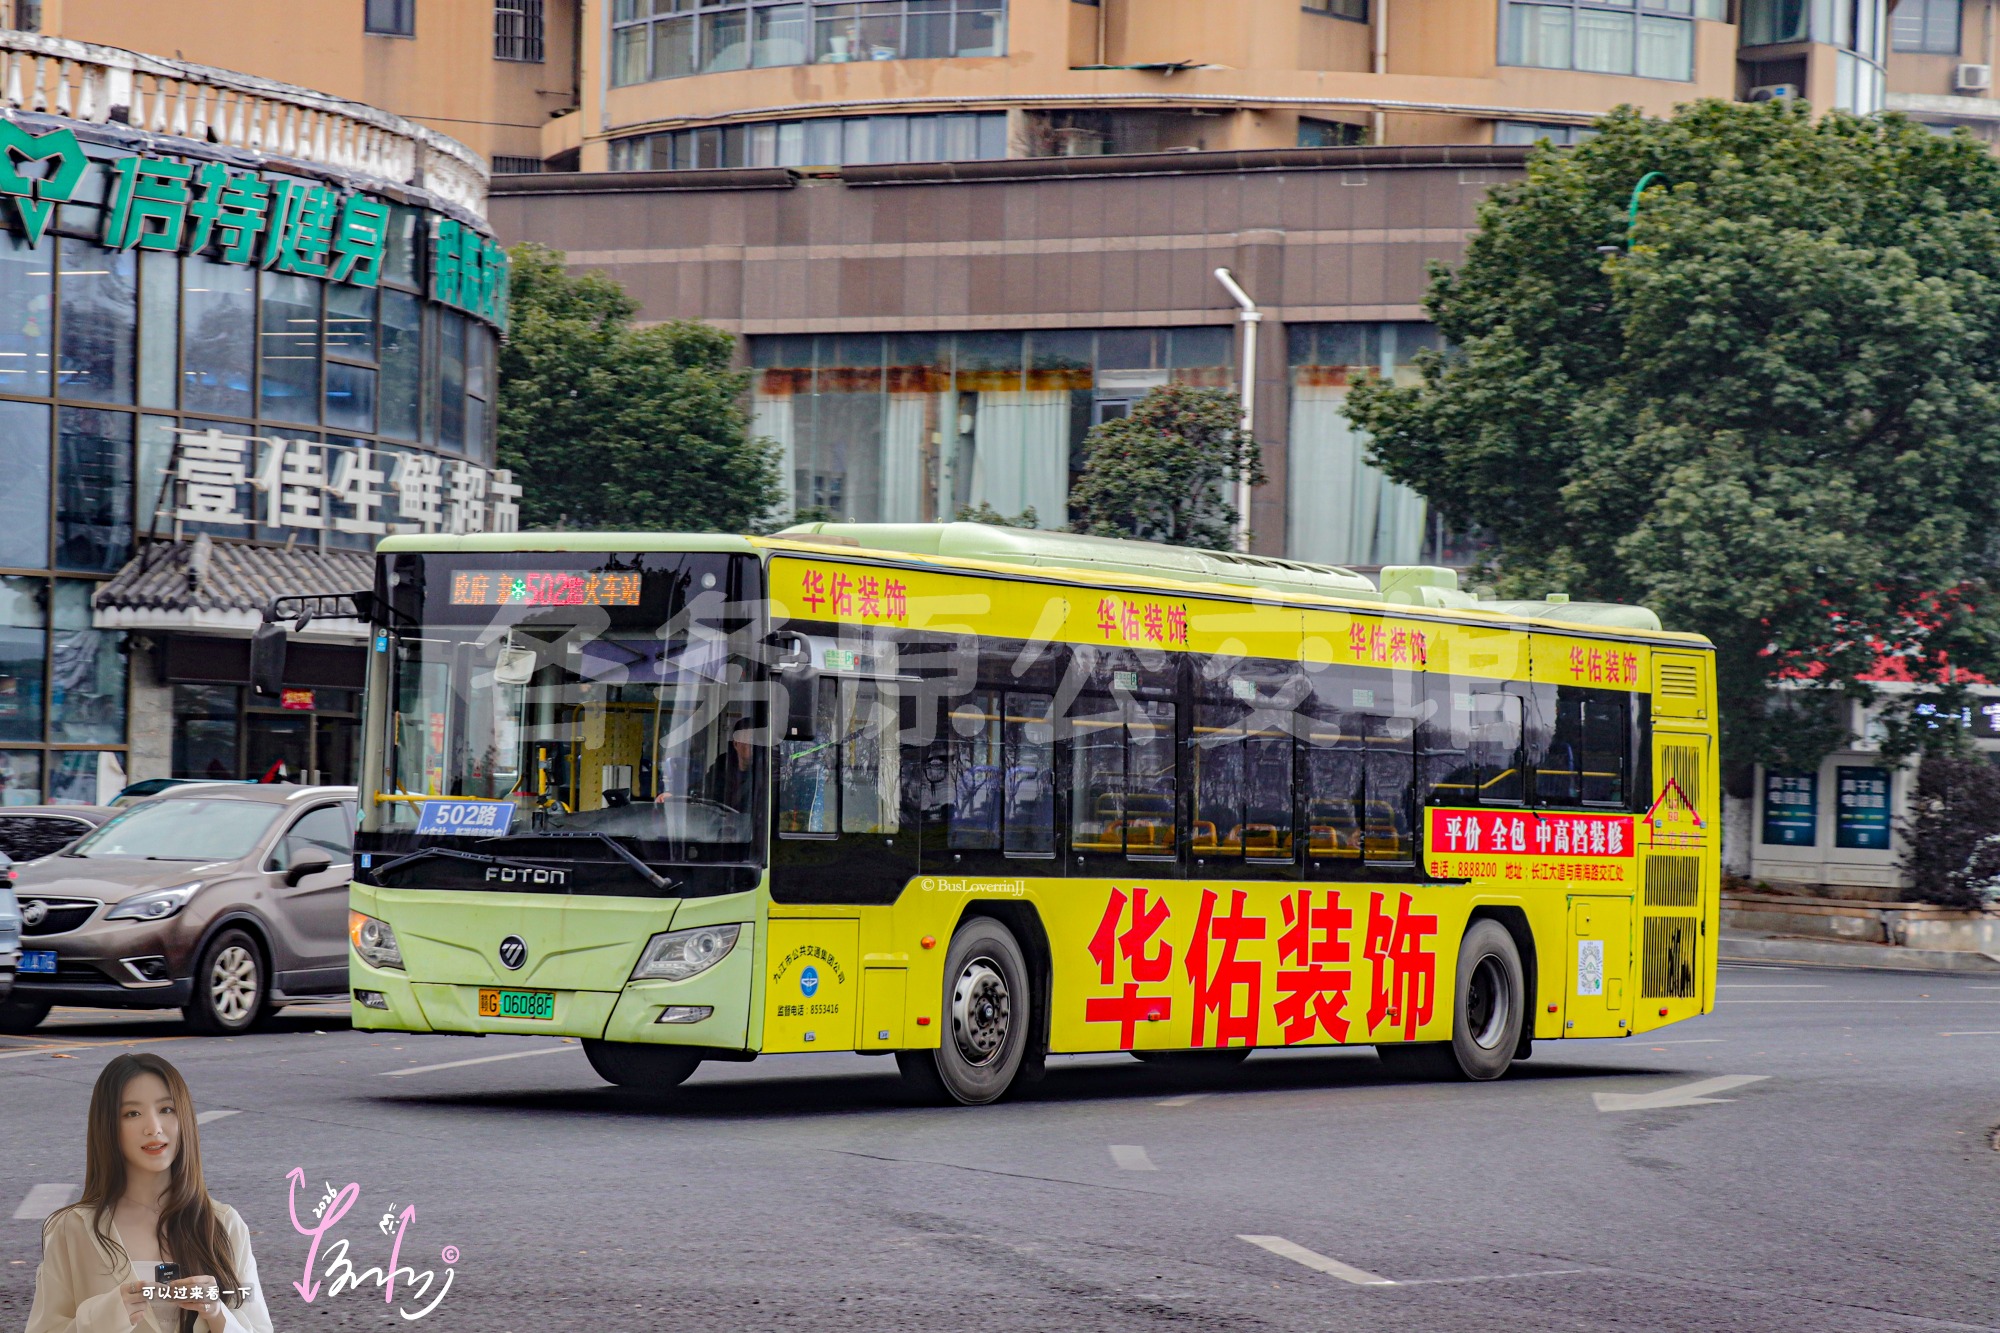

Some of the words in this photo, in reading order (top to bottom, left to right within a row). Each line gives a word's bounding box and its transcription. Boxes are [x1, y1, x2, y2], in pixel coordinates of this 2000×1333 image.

[102, 155, 391, 289] 倍特健身
[176, 429, 524, 535] 壹佳生鲜超市
[585, 573, 641, 605] 火车站
[802, 569, 907, 621] 华佑装饰
[1097, 598, 1187, 644] 华佑装饰
[1349, 622, 1427, 665] 华佑装饰
[1570, 646, 1637, 686] 华佑装饰
[435, 804, 498, 827] 502路
[1444, 816, 1482, 851] 平价
[1491, 817, 1526, 852] 全包
[1535, 818, 1624, 855] 中高档装修
[485, 867, 565, 884] FOTON
[773, 944, 846, 984] 九江市公共交通集团公司
[1085, 886, 1438, 1050] 华佑装饰
